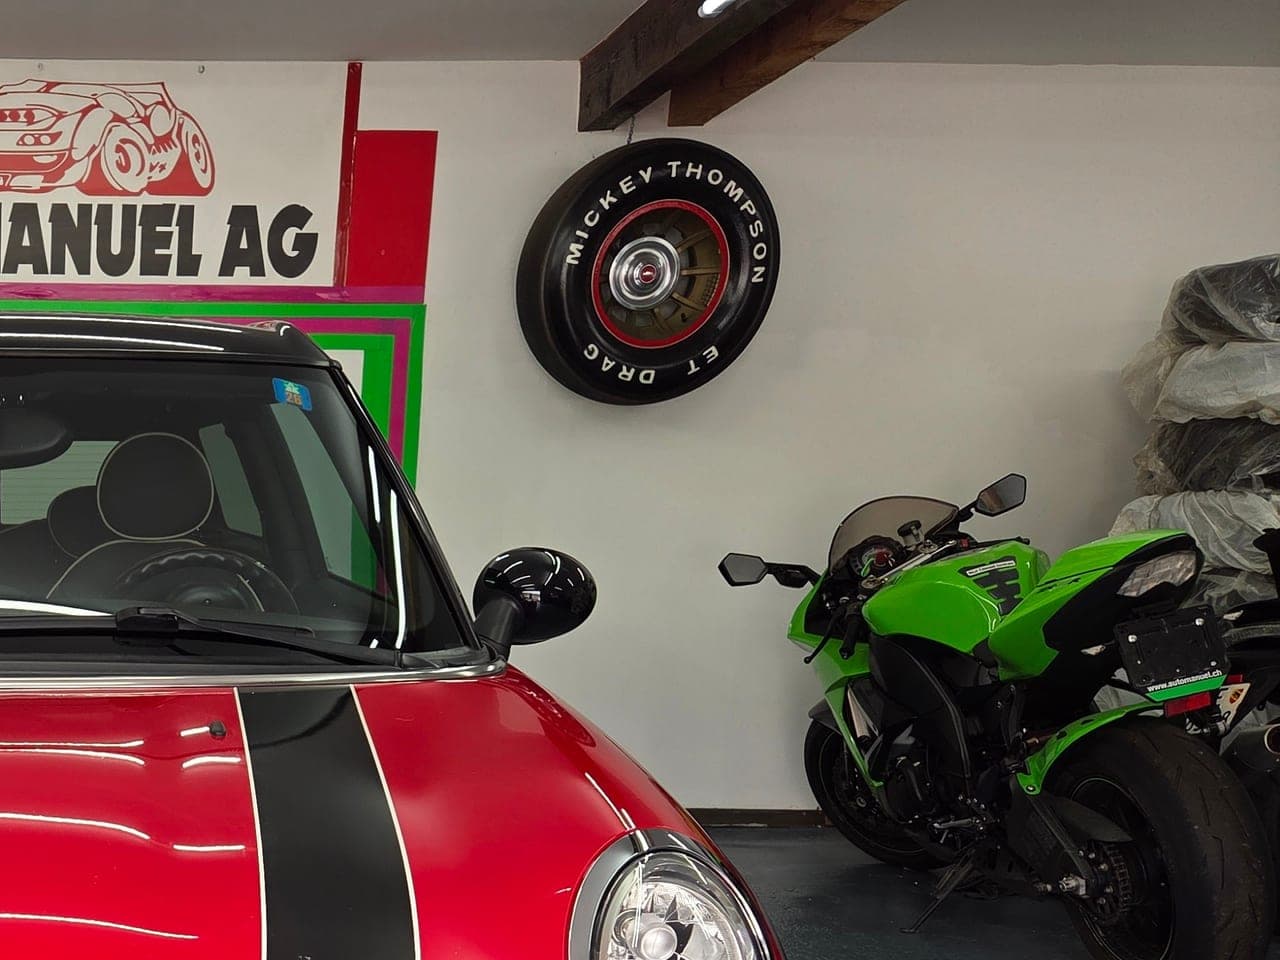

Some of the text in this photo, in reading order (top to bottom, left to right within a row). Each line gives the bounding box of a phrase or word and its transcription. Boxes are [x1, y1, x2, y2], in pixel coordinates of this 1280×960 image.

[218, 203, 319, 279] AG
[566, 160, 767, 284] MICKEY THOMPSON
[583, 342, 720, 384] ET DRAG
[1147, 670, 1222, 691] www.automanuel.ch
